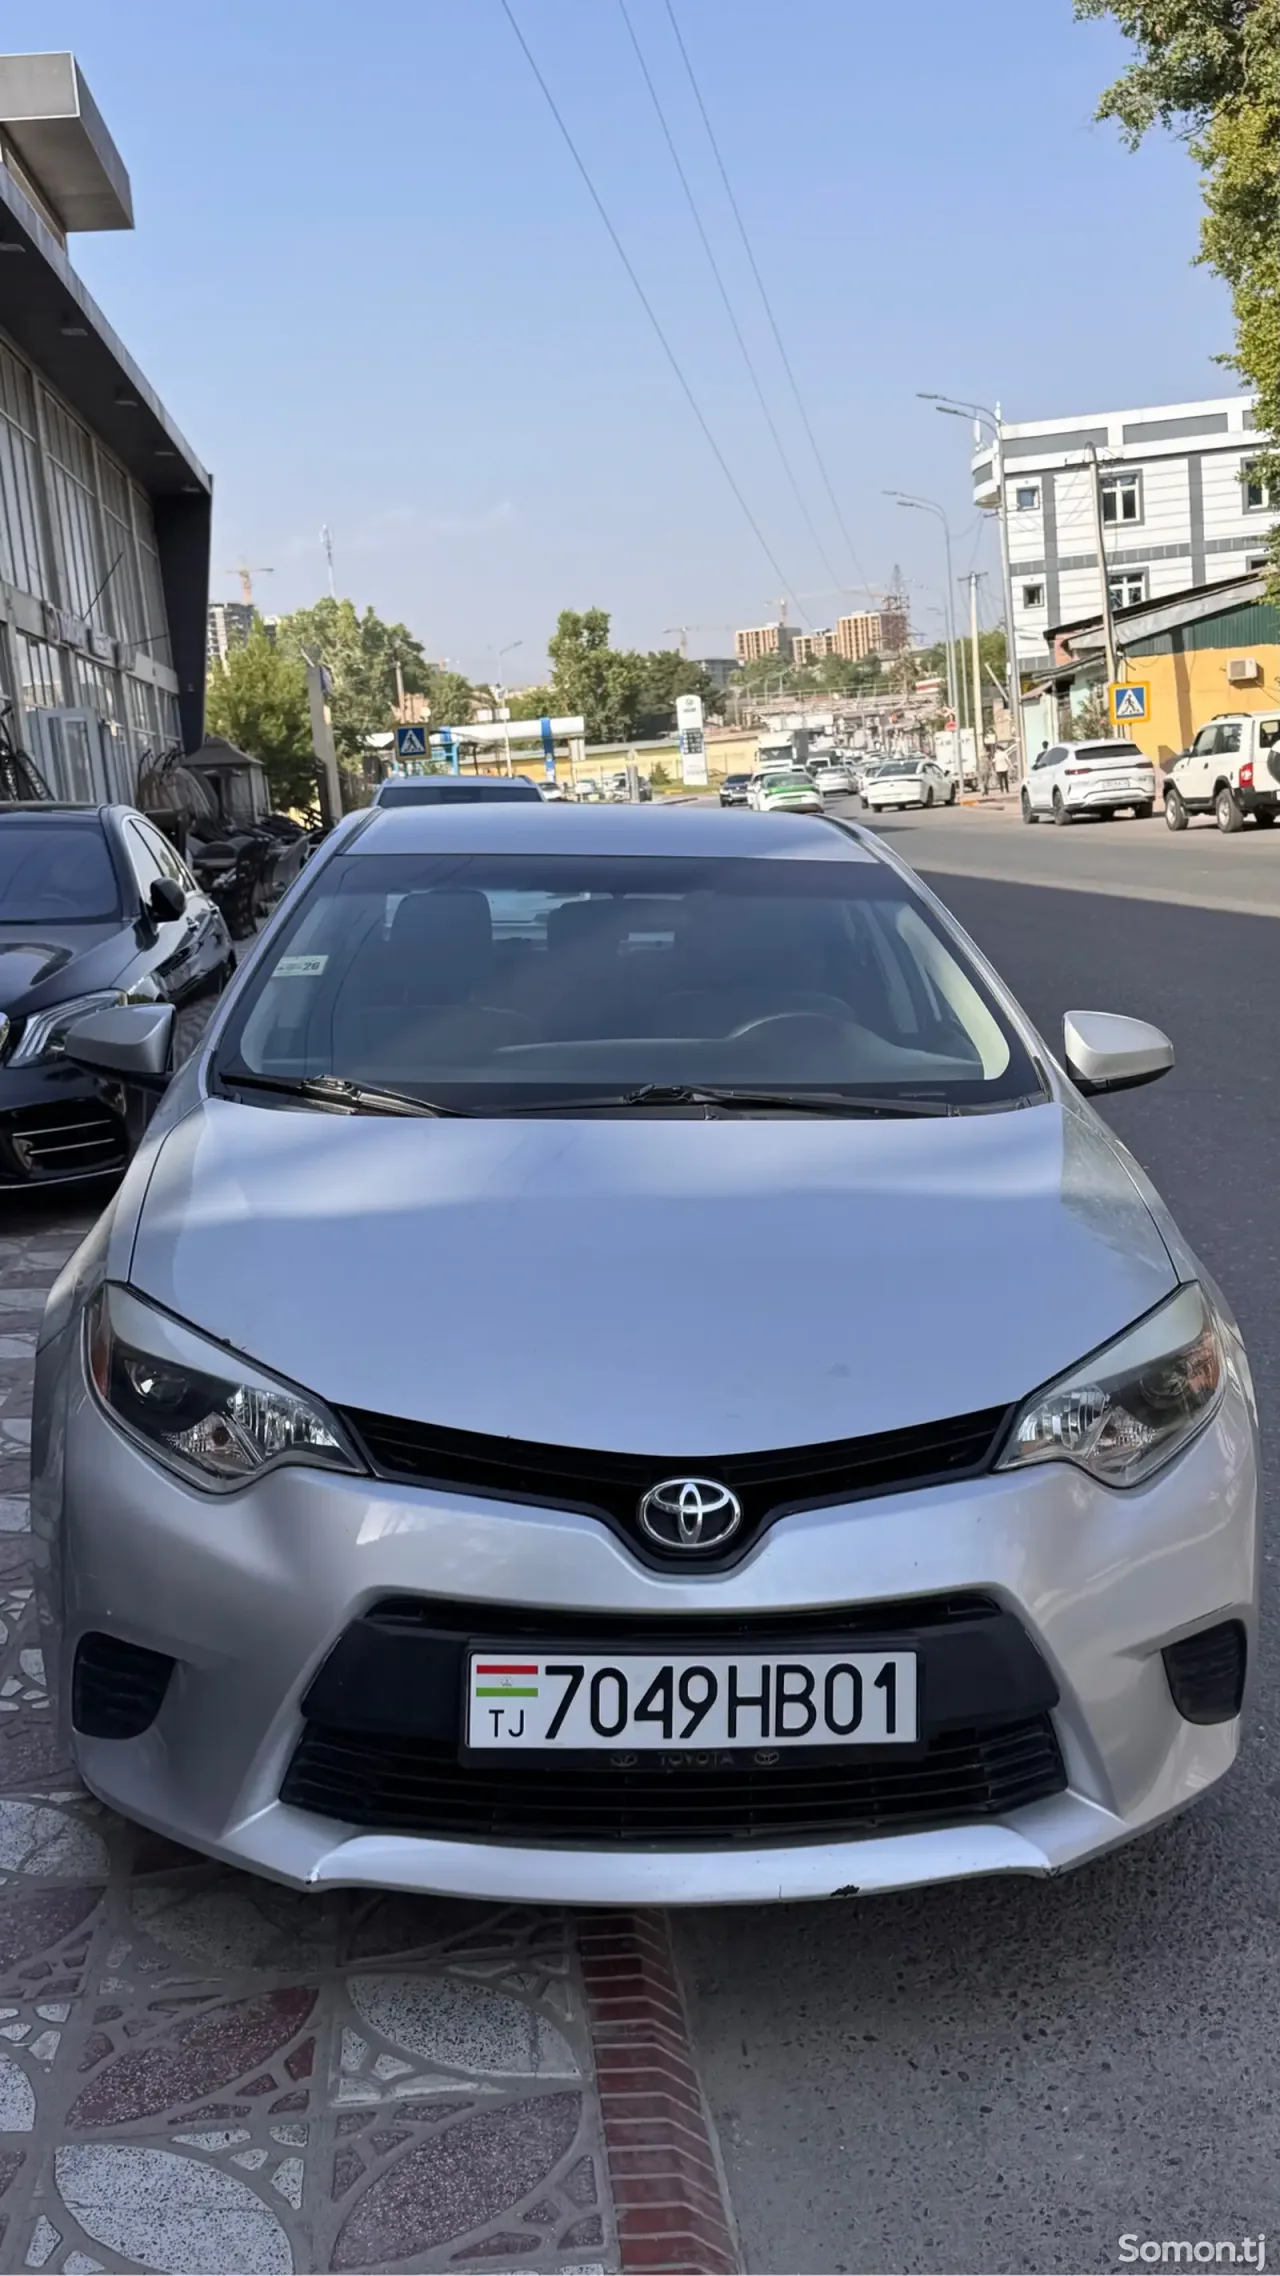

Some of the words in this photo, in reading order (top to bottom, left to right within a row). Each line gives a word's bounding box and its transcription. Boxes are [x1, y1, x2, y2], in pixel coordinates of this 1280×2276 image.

[545, 1662, 897, 1740] 7049HB01
[489, 1709, 525, 1738] TJ
[657, 1751, 735, 1767] TOYOTA
